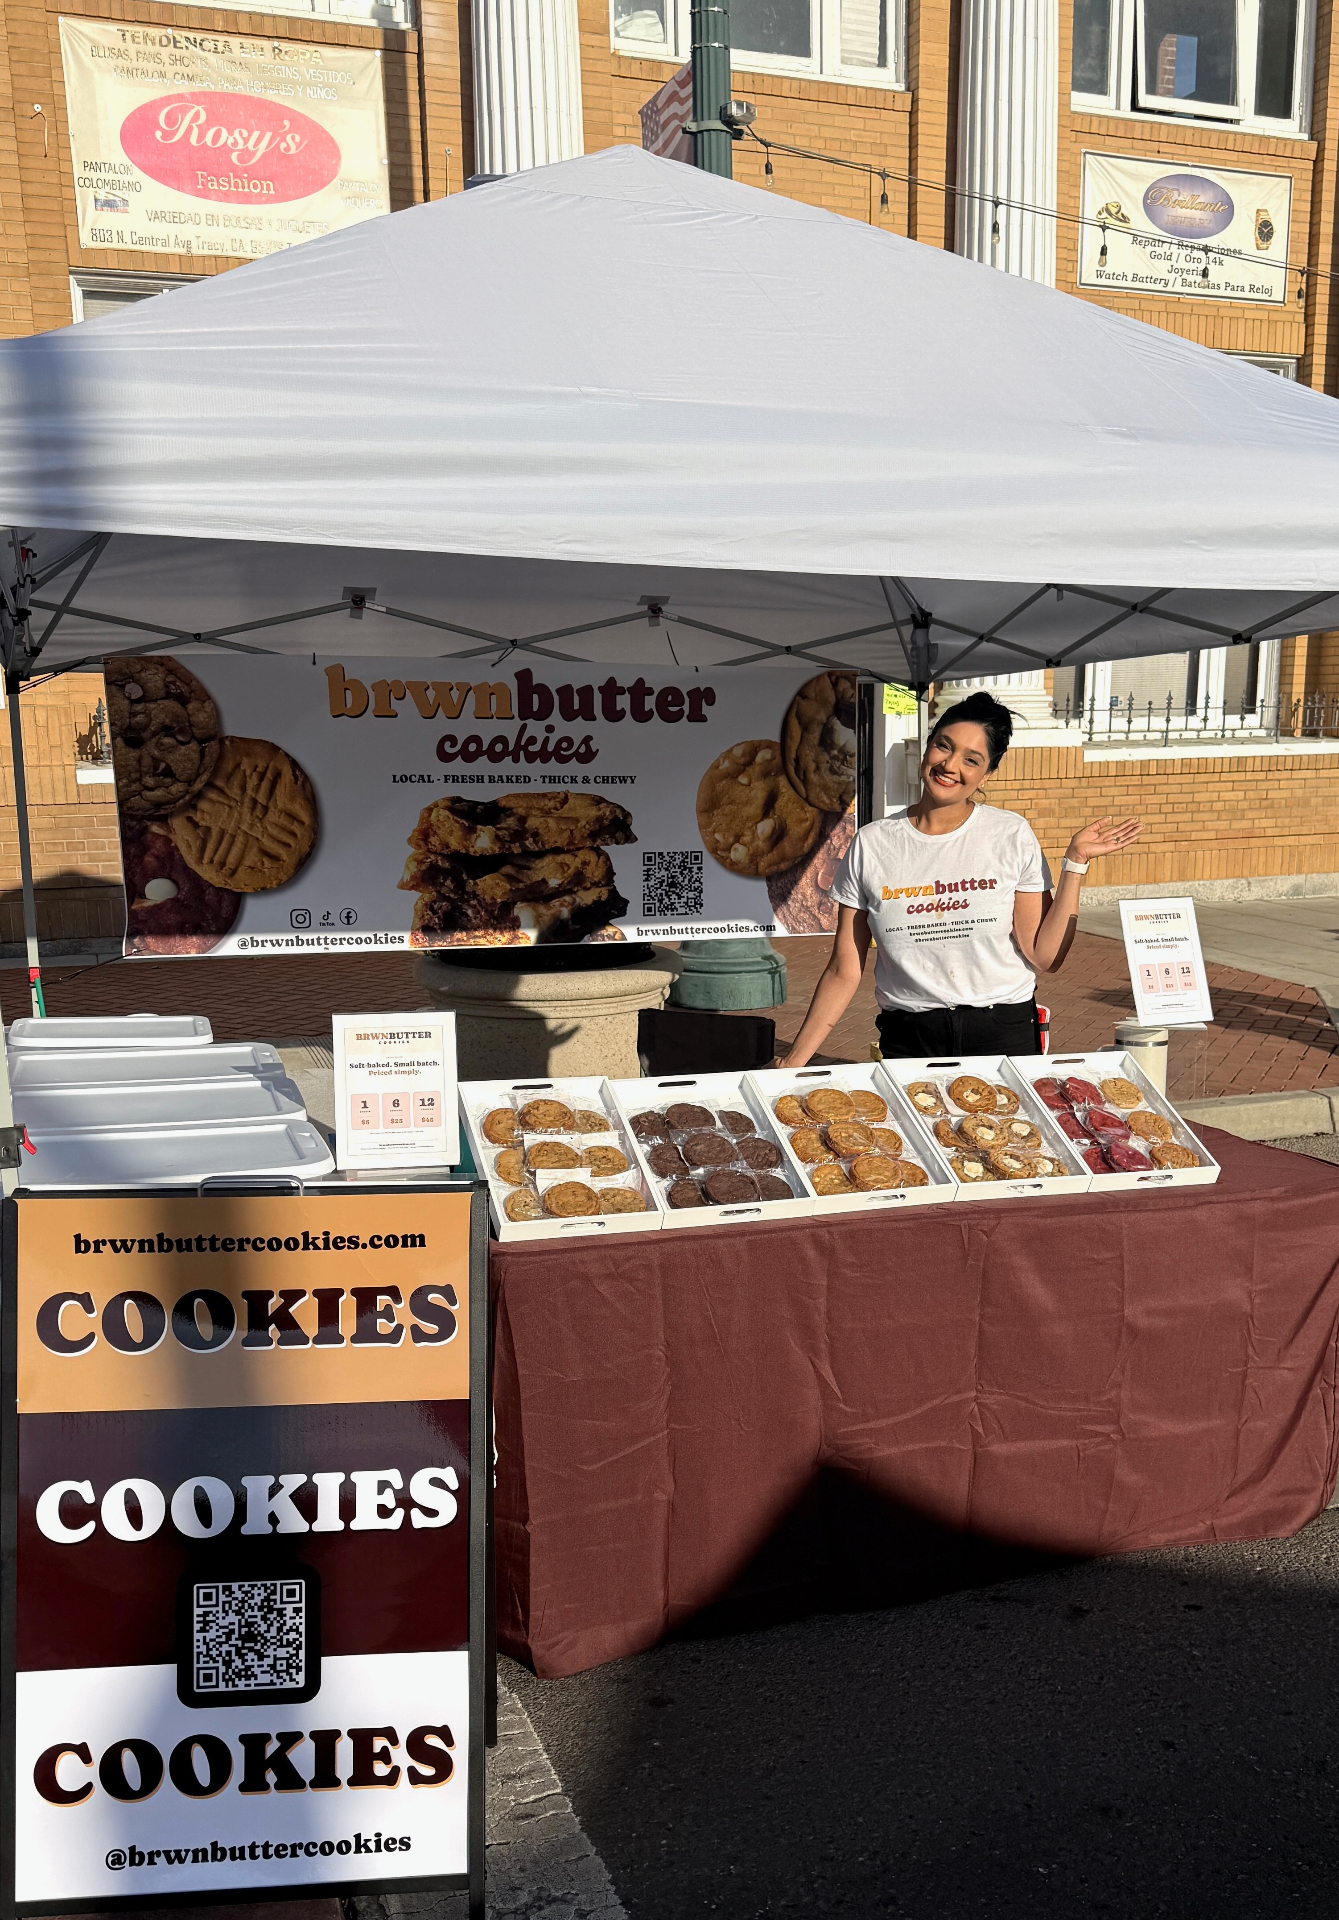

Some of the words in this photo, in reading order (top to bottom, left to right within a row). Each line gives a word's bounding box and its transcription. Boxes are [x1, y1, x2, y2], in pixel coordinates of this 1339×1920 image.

[117, 28, 234, 55] TENDENCIA
[240, 42, 265, 59] EN
[272, 45, 324, 65] ROPA
[218, 77, 244, 91] PARA
[296, 85, 304, 97] Y
[306, 84, 338, 100] NIÑOS
[155, 102, 308, 166] Rosy's
[83, 160, 133, 175] PANTALON
[77, 176, 142, 192] COLOMBIANO
[195, 171, 275, 194] Fashion
[1147, 186, 1229, 213] Brillante
[145, 209, 202, 226] VARIEDAD
[205, 213, 219, 227] EN
[90, 228, 113, 243] 803
[116, 230, 128, 245] N.
[130, 231, 170, 247] Central
[1131, 236, 1164, 249] Repair
[1149, 250, 1173, 261] Gold
[1184, 253, 1202, 264] Oro
[1206, 256, 1224, 266] 14k
[1096, 270, 1128, 281] Watch
[1131, 273, 1169, 288] Battery
[1224, 282, 1245, 292] Para
[1248, 284, 1273, 297] Reloj
[324, 663, 717, 724] brwnbutter
[435, 722, 599, 765] cookies
[392, 774, 434, 784] LOCAL
[443, 774, 485, 784] FRESH
[488, 775, 531, 784] BAKED
[540, 775, 578, 785] THICK
[581, 775, 591, 784] &
[593, 775, 637, 785] CHEWY
[881, 877, 998, 900] brwnbutter
[906, 897, 970, 915] cookies
[636, 923, 776, 937] brwnbuttercookies.com
[237, 933, 405, 949] @brwnbuttercookies
[1164, 967, 1170, 975] 6
[1180, 966, 1191, 974] 12
[356, 1031, 432, 1040] BRWNBUTTER
[349, 1061, 392, 1069] Soft-baked.
[394, 1068, 421, 1076] simply.
[361, 1100, 369, 1109] 1
[392, 1098, 400, 1108] 6
[419, 1097, 435, 1107] 12
[73, 1229, 427, 1255] brwnbuttercookies.com
[35, 1283, 460, 1356] COOKIES
[35, 1466, 461, 1545] COOKIES
[33, 1724, 455, 1806] COOKIES
[105, 1832, 412, 1872] @brwnbuttercookies
